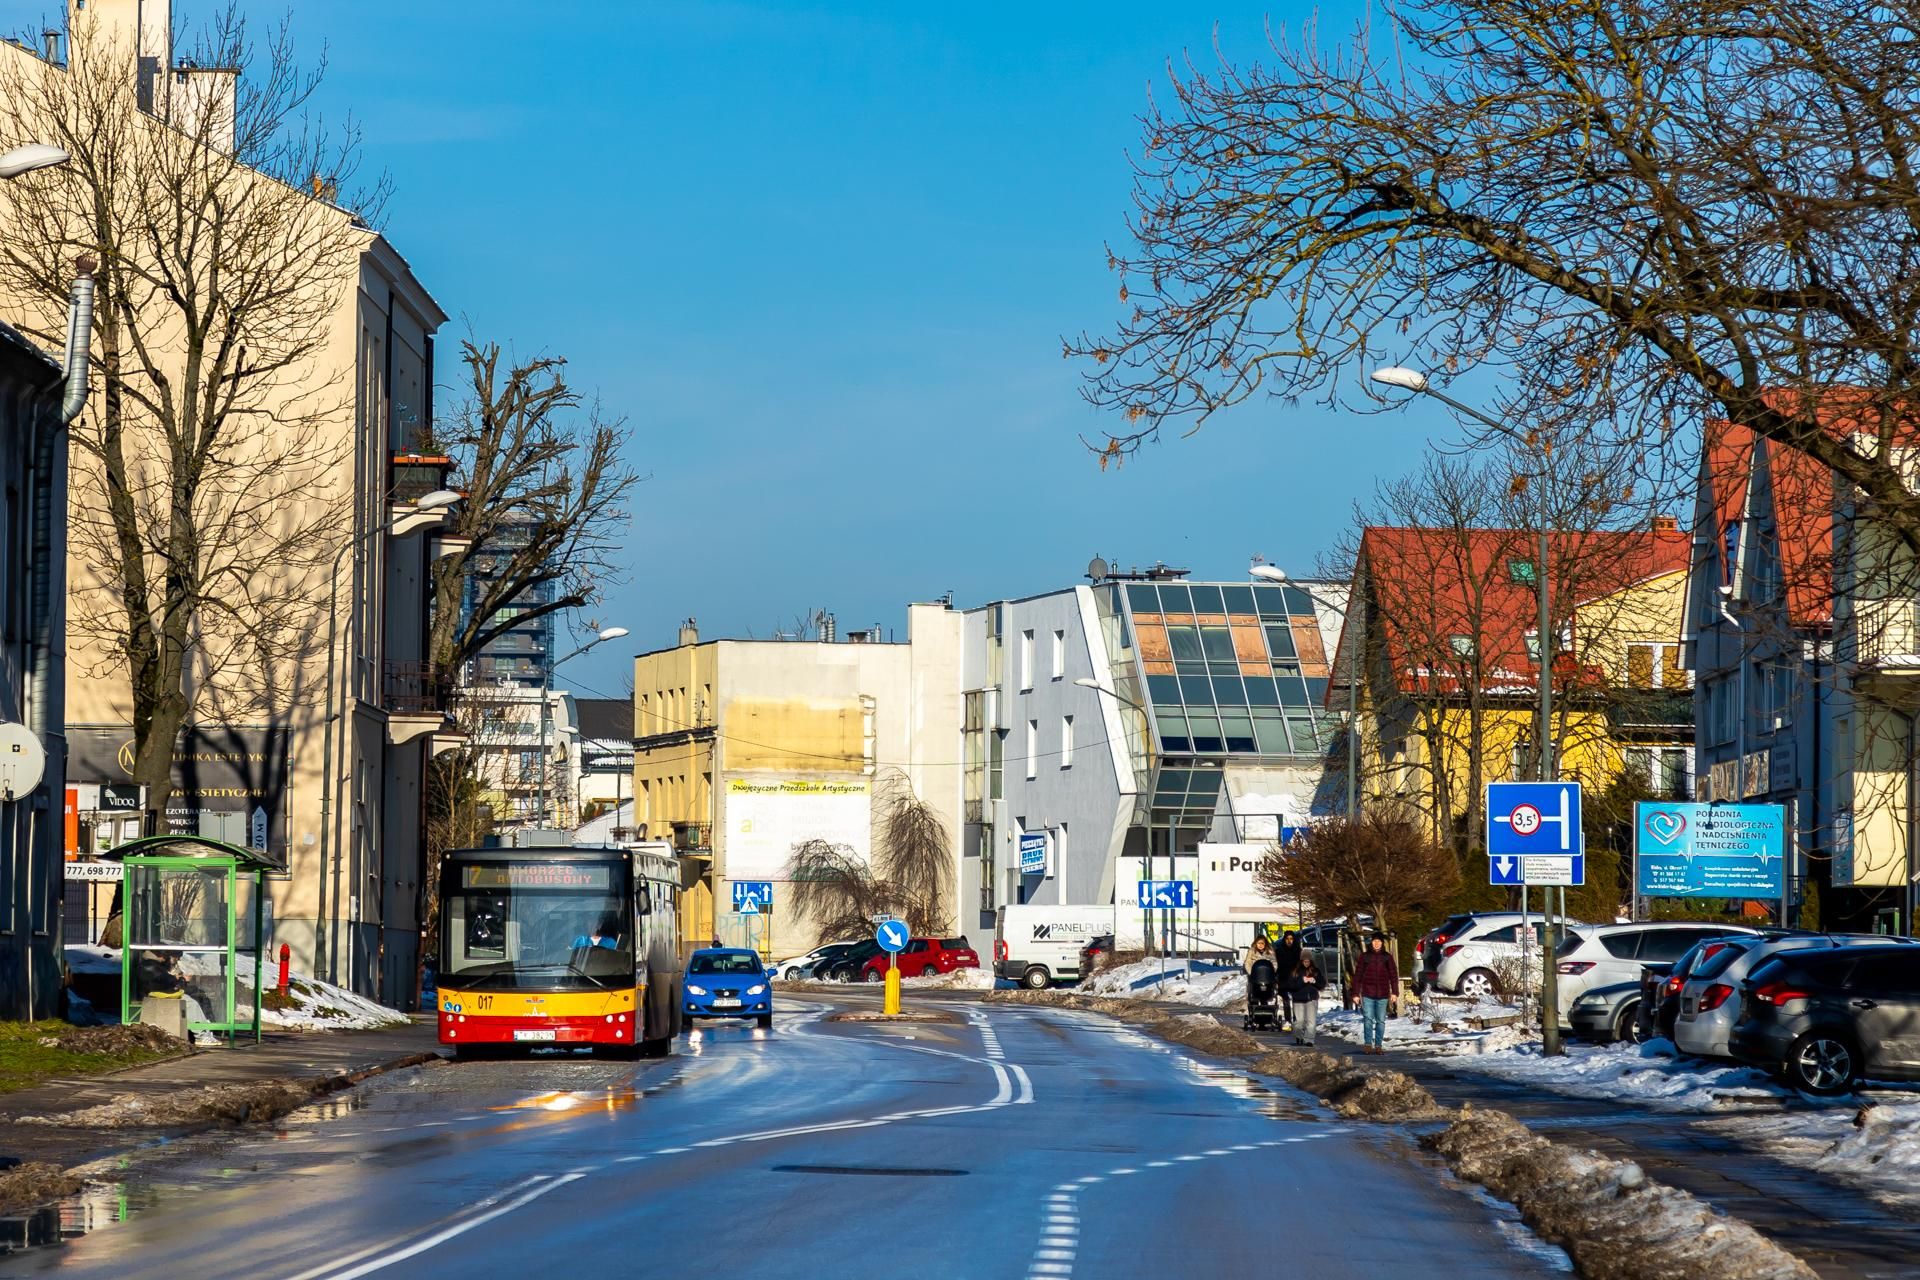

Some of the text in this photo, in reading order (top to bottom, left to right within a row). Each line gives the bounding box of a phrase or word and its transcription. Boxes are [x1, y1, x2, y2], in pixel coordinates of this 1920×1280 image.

[172, 752, 213, 762] LINIKA
[733, 783, 866, 794] Dwujęzyczne Przedszkole Artystyczne
[109, 798, 135, 807] VIDOQ
[166, 808, 212, 816] EZOTERAPIA
[1696, 810, 1742, 818] PORADNIA
[1702, 831, 1767, 839] NADCIŚNIENIA
[1696, 842, 1750, 850] TĘTNICZEGO
[1022, 849, 1044, 859] DRUK
[1230, 856, 1266, 872] Par
[66, 866, 122, 876] 777, 698 777
[470, 865, 482, 885] 7
[1051, 923, 1112, 933] PANELPLUS
[1204, 928, 1215, 936] 93
[478, 995, 493, 1010] 017
